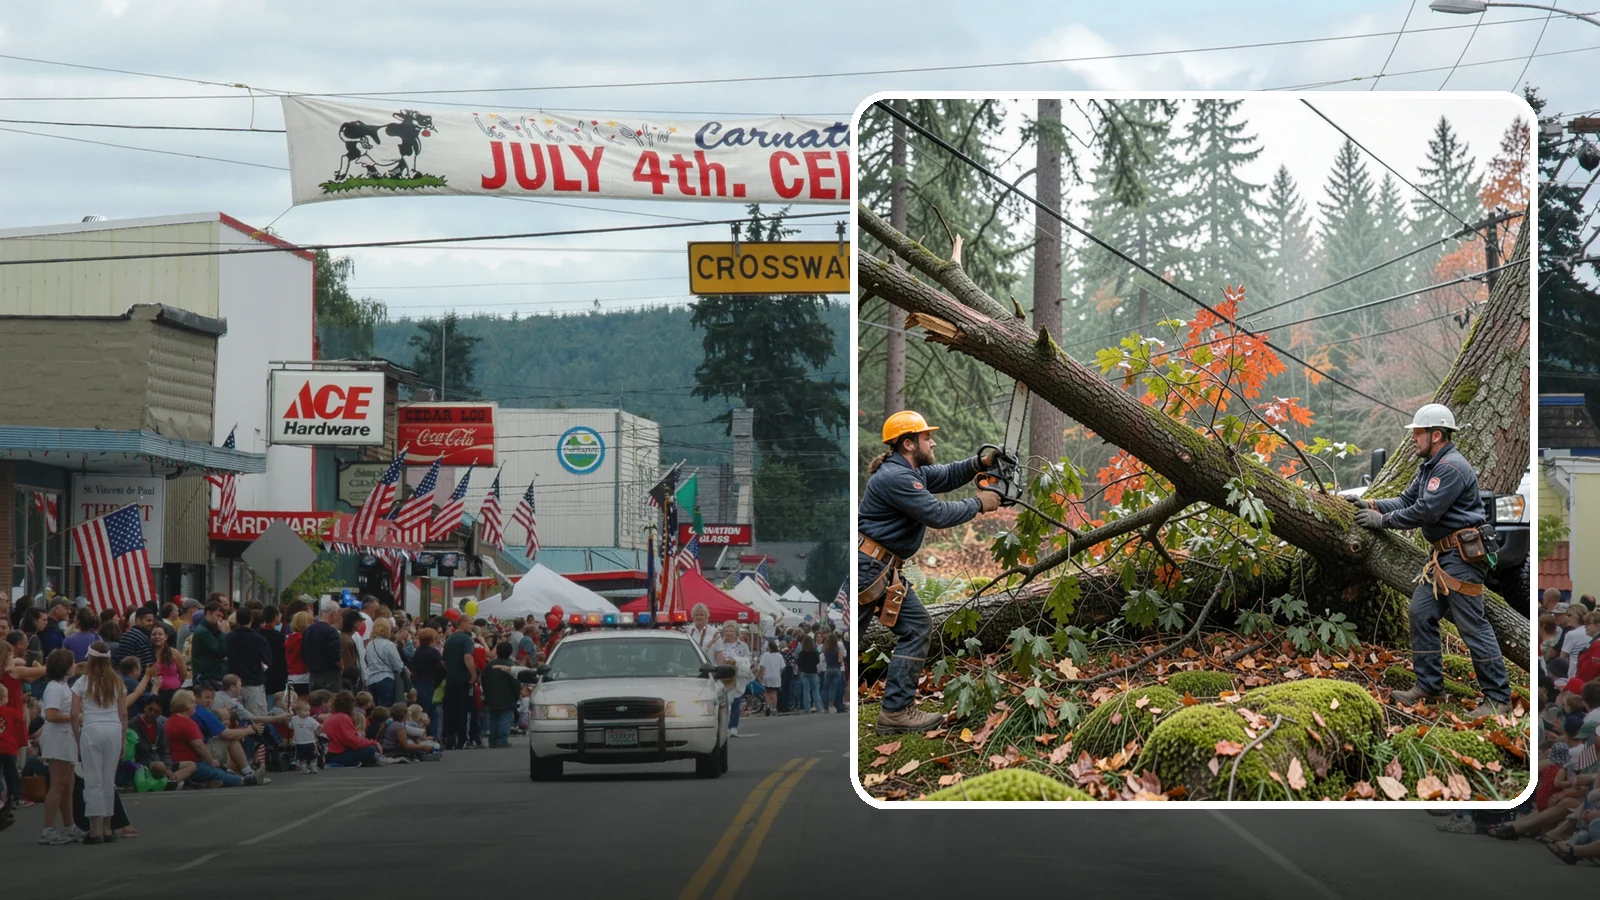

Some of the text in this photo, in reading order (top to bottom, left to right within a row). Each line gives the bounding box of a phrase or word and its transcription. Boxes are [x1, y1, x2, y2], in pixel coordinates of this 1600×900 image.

[695, 121, 850, 150] Carnat
[481, 141, 605, 193] JULY
[632, 150, 746, 198] 4th.
[696, 254, 850, 280] CROSSWA
[283, 380, 373, 420] ACE
[405, 410, 452, 422] CEDAR
[283, 421, 371, 436] Hardware
[416, 428, 477, 447] Coca-Cola
[353, 467, 385, 481] Simpl
[83, 484, 155, 495] St. Vincent de Paul
[213, 516, 330, 535] HARDARE
[688, 526, 741, 535] CRNATION
[699, 535, 730, 543] GLASS
